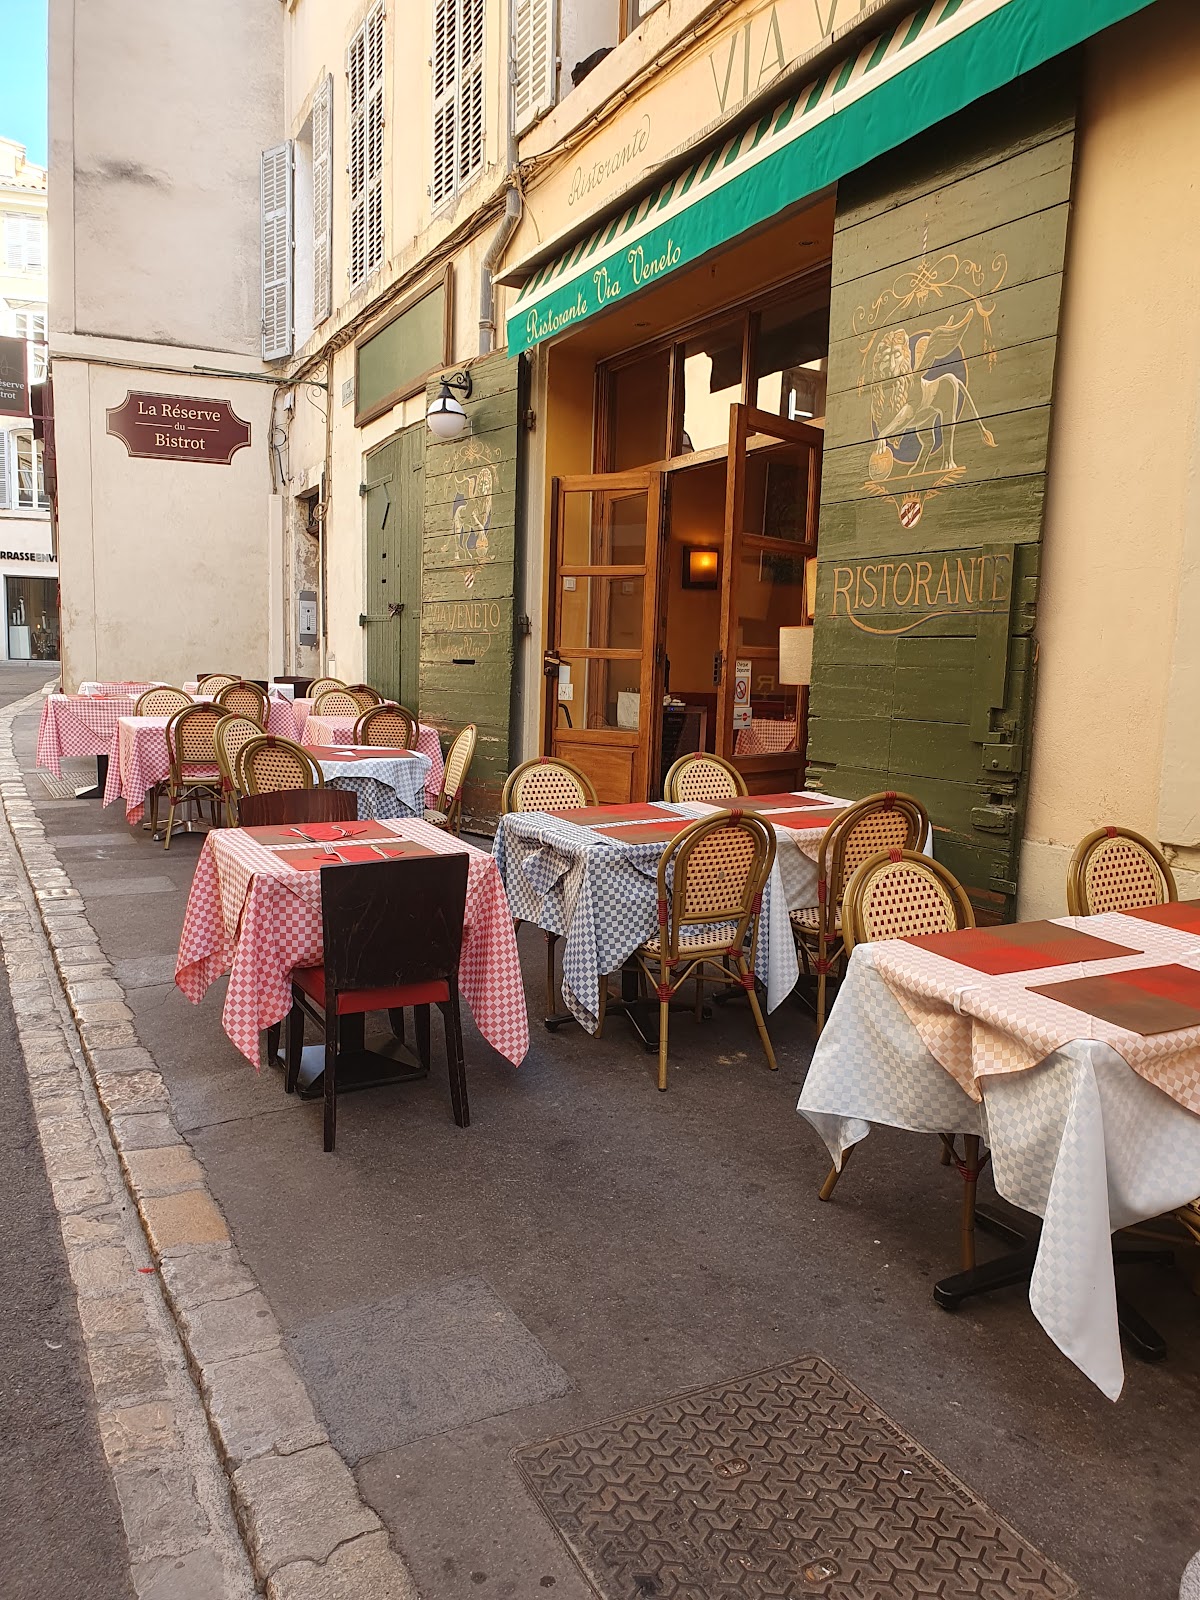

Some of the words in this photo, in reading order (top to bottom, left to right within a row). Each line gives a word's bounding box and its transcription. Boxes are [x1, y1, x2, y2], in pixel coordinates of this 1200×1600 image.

[708, 3, 786, 113] VIA
[567, 113, 651, 206] Ristorante
[526, 293, 588, 343] Ristorante
[593, 266, 622, 304] Via
[628, 238, 682, 285] Veneto
[138, 401, 157, 416] La
[161, 403, 221, 422] Réserve
[174, 421, 186, 431] du
[154, 432, 206, 450] Bistrot
[829, 553, 1011, 620] RISTORANTE
[446, 603, 500, 631] VENETO
